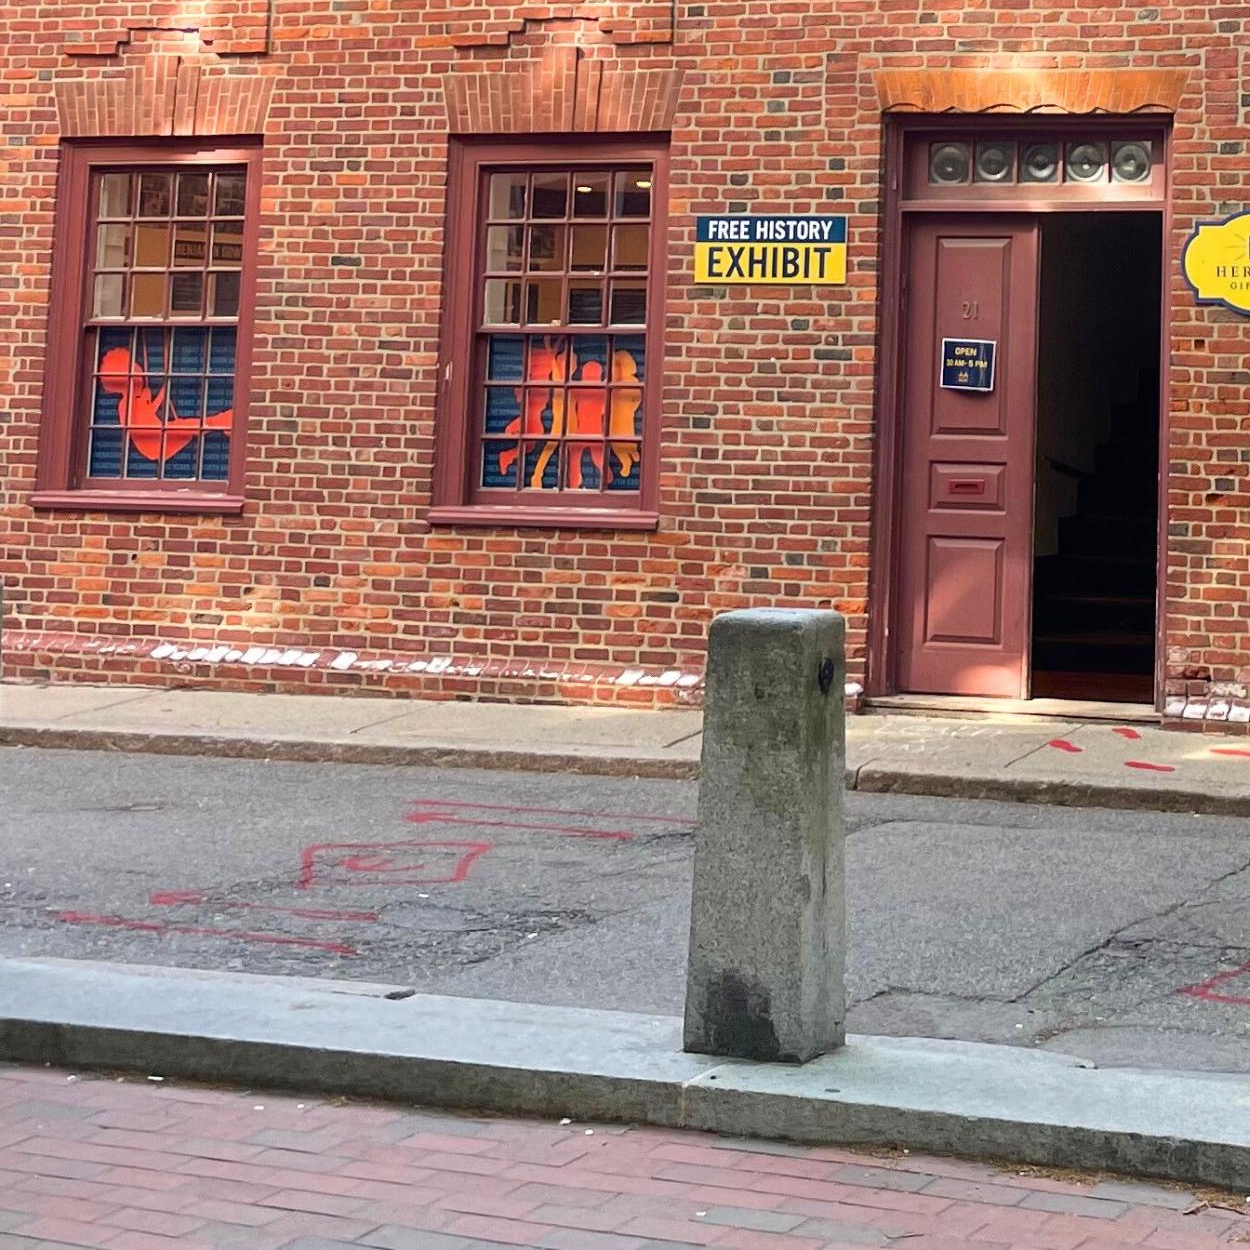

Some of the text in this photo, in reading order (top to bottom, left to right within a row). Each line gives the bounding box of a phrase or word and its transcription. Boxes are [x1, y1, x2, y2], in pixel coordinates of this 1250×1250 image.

[708, 220, 833, 240] FREE HISTORY
[707, 246, 832, 278] EXHIBIT
[962, 301, 978, 319] 21
[954, 347, 977, 356] OPEN
[975, 360, 988, 368] PM
